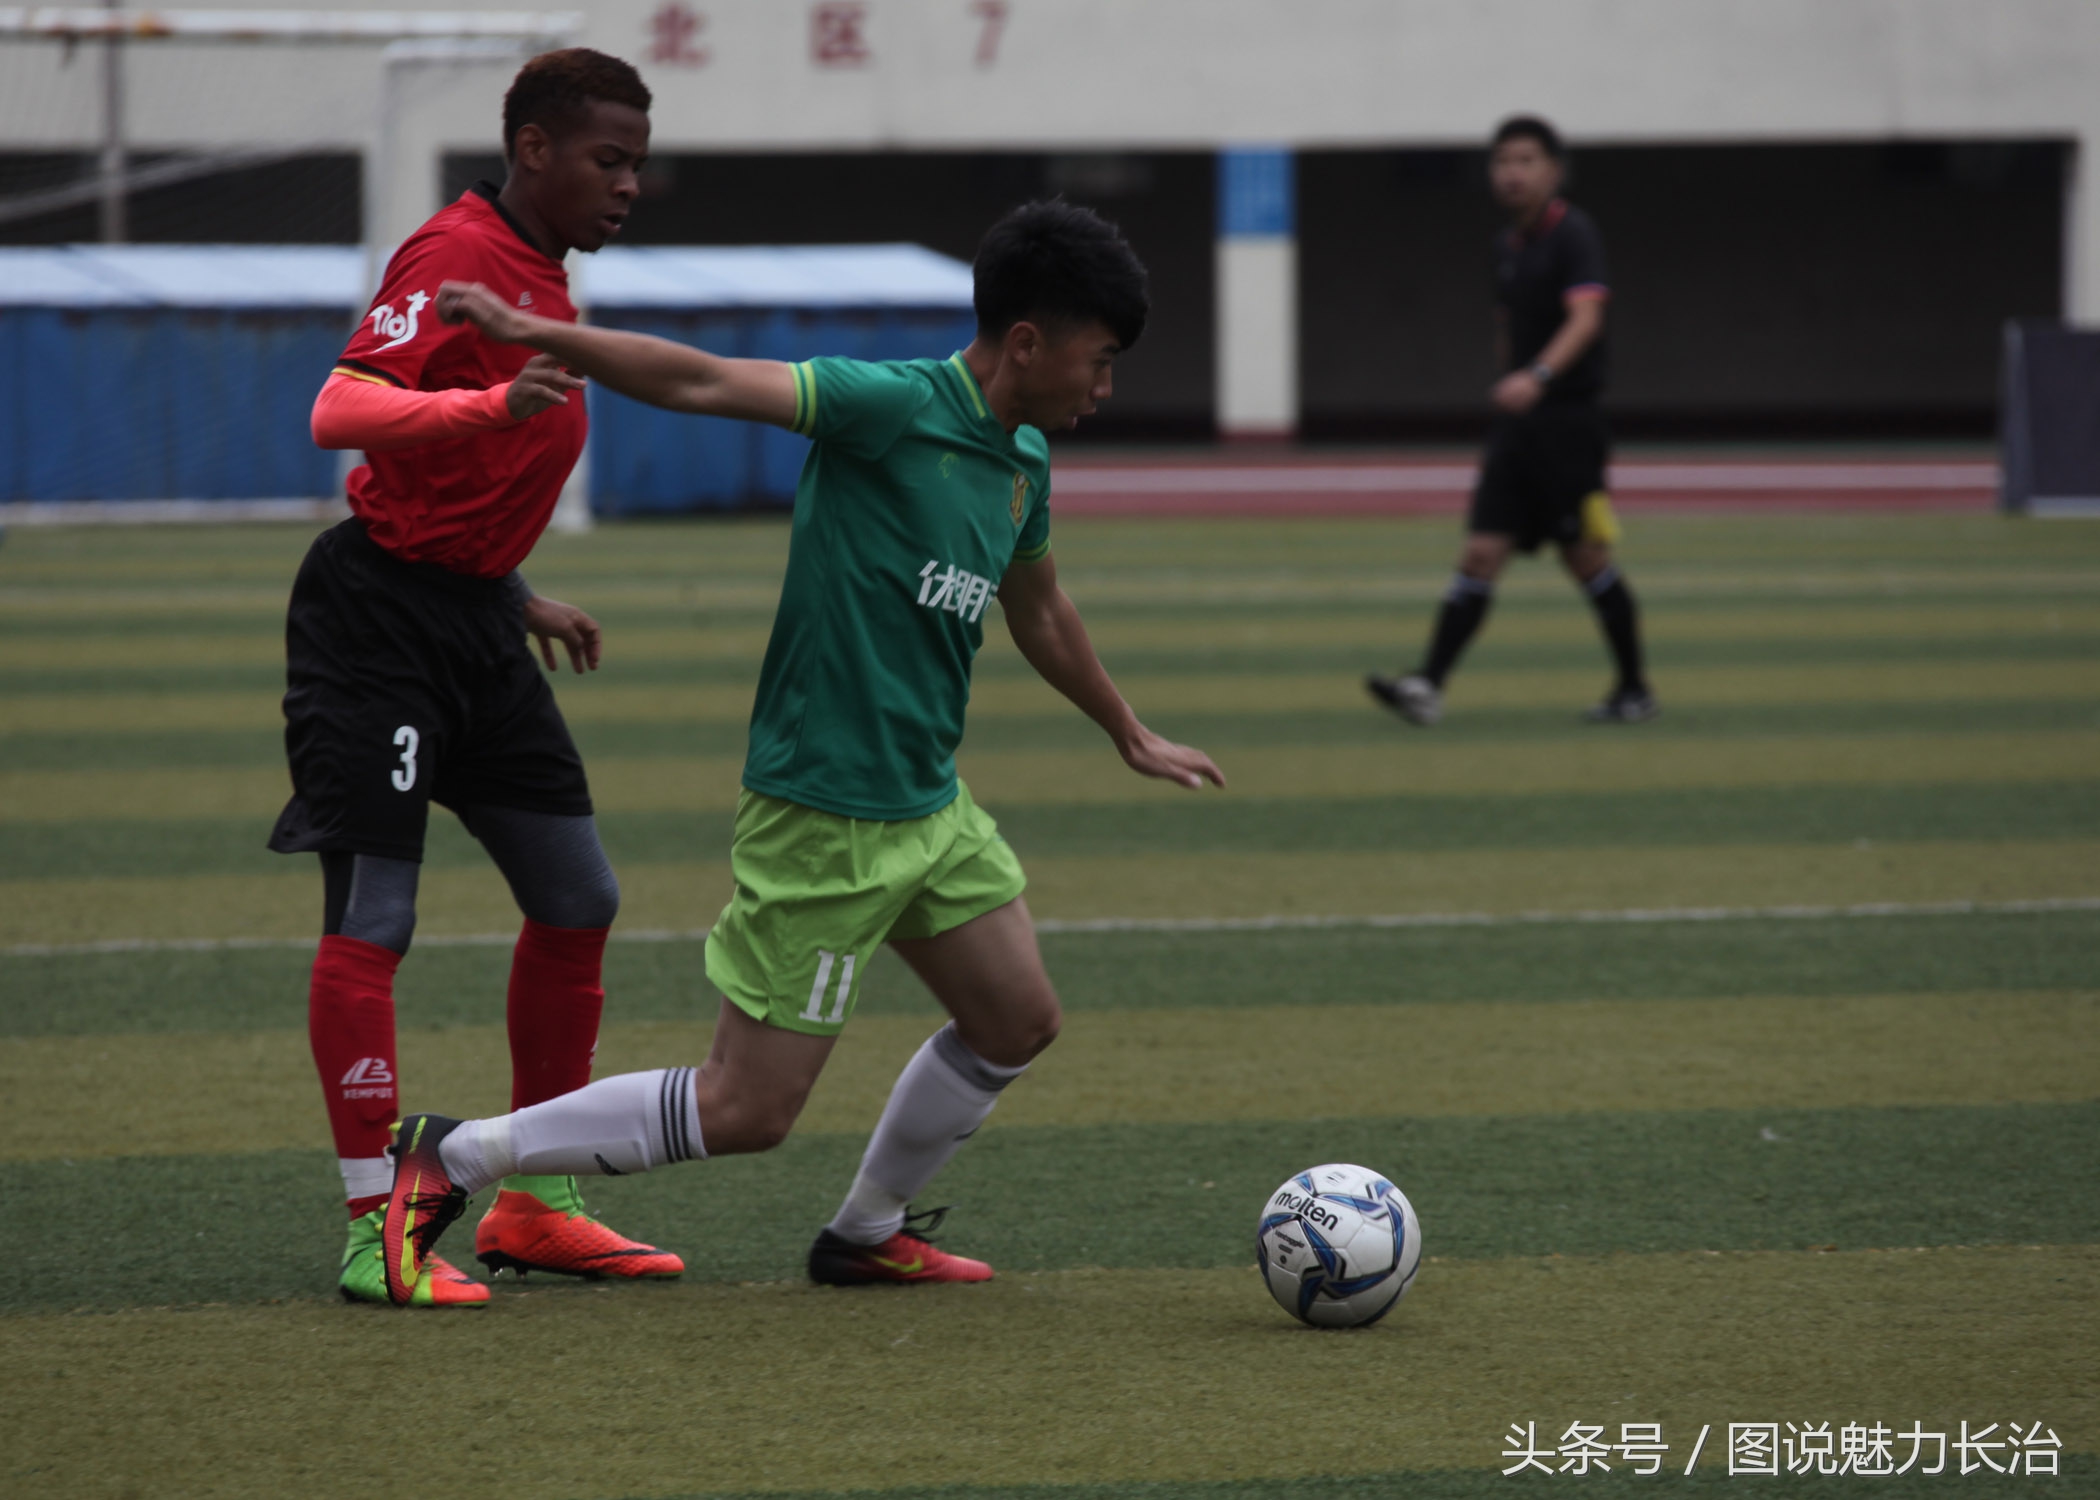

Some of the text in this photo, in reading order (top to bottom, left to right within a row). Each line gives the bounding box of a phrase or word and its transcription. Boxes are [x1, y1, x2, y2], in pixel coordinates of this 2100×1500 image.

[390, 725, 420, 792] 3
[798, 949, 857, 1023] 11
[1274, 1191, 1340, 1232] molten
